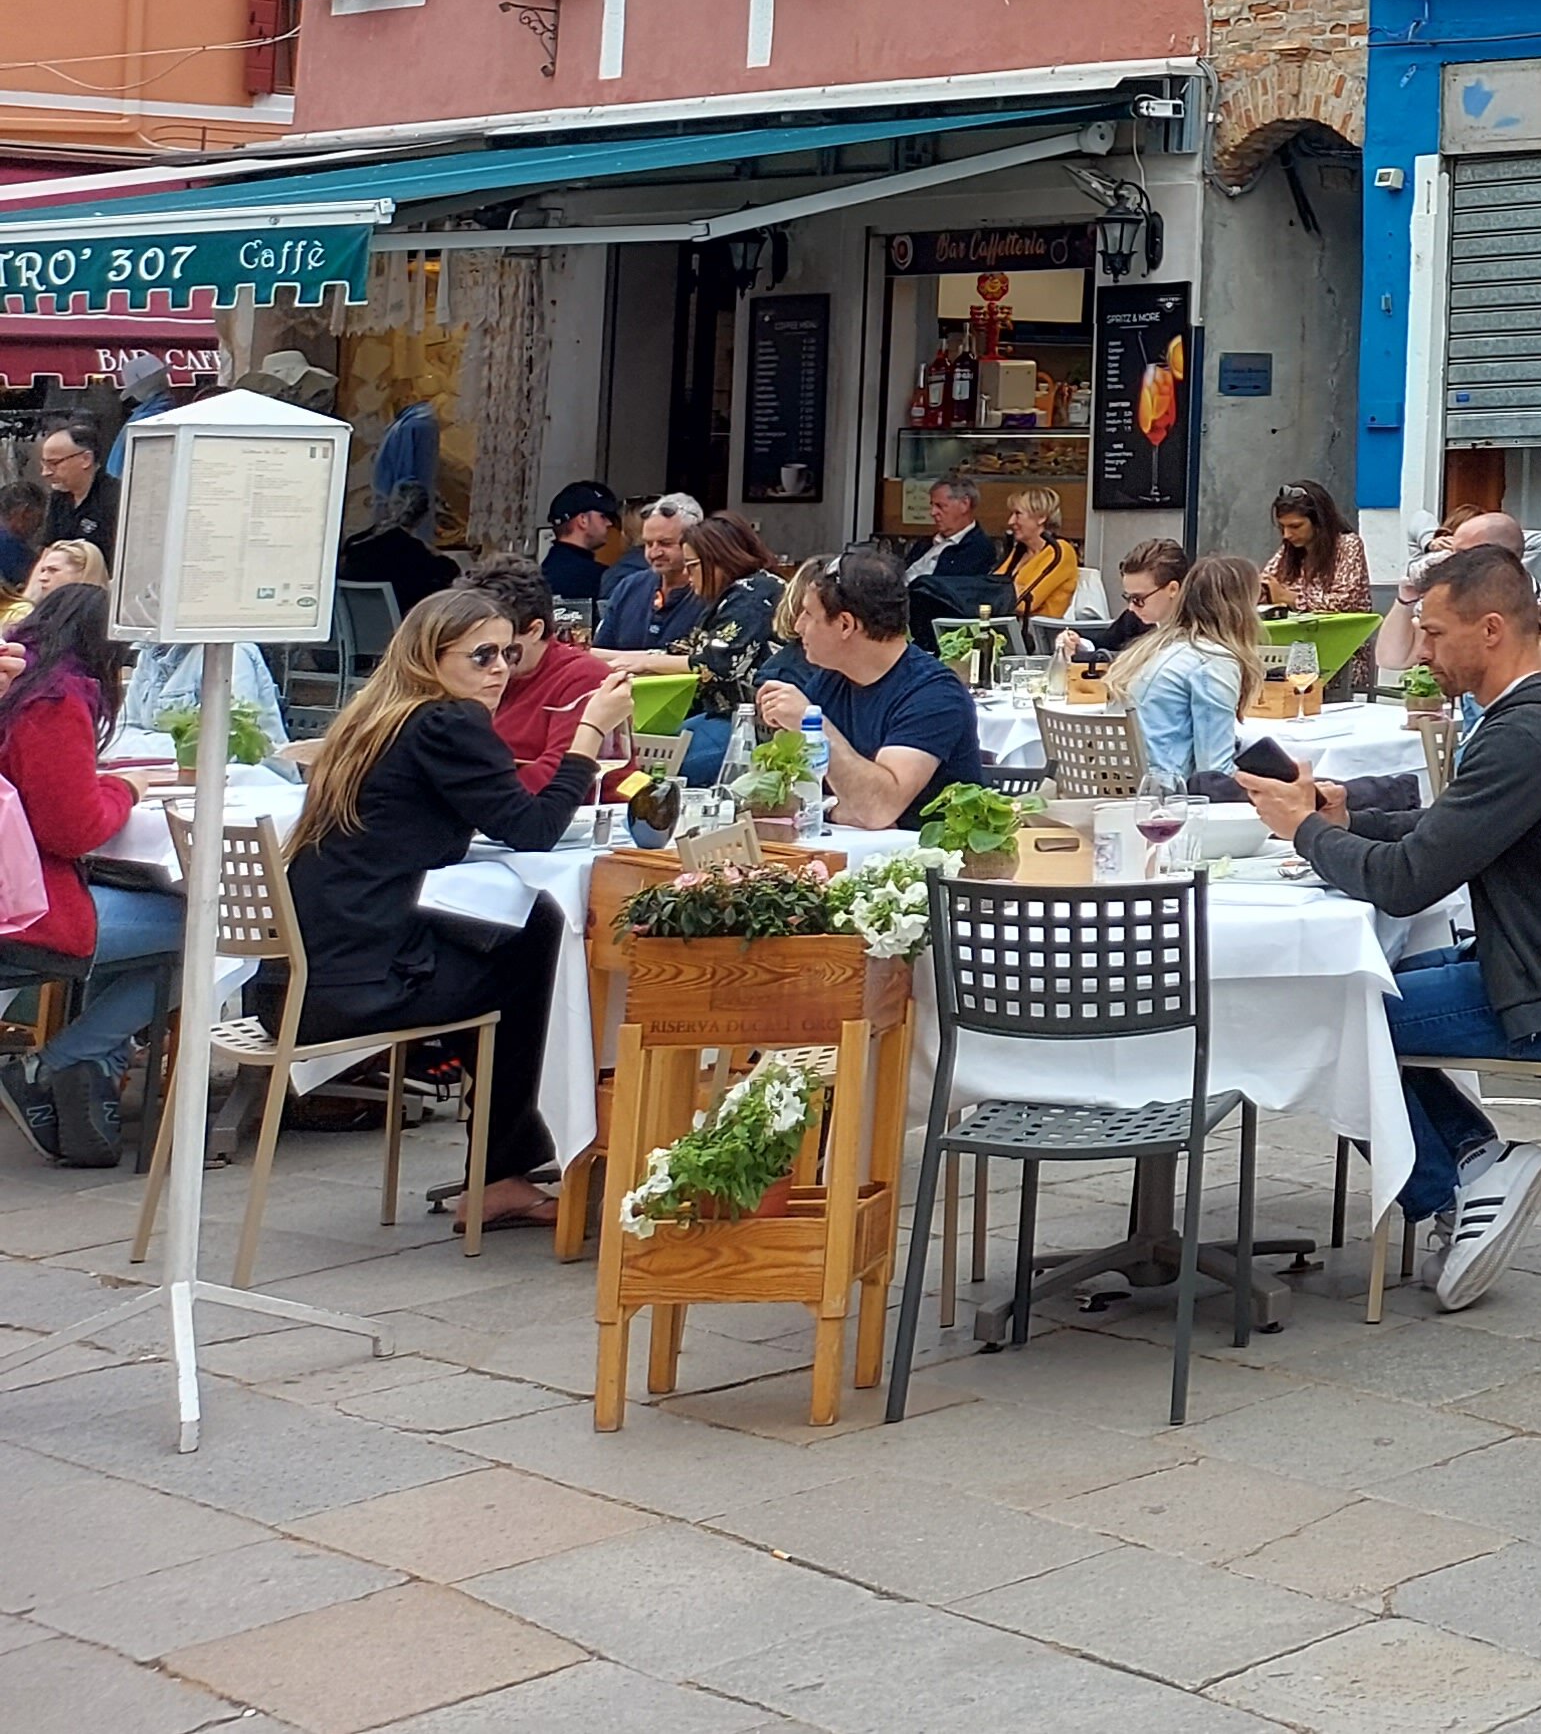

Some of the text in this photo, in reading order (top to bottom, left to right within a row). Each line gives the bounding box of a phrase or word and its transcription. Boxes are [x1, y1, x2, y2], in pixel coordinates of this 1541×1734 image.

[936, 229, 1047, 266] Bar Caffetteria
[107, 245, 197, 282] 307
[239, 239, 326, 275] Caffè
[1107, 313, 1132, 324] SPRITZ
[1139, 311, 1161, 322] MORE
[650, 1019, 720, 1033] RISERVA
